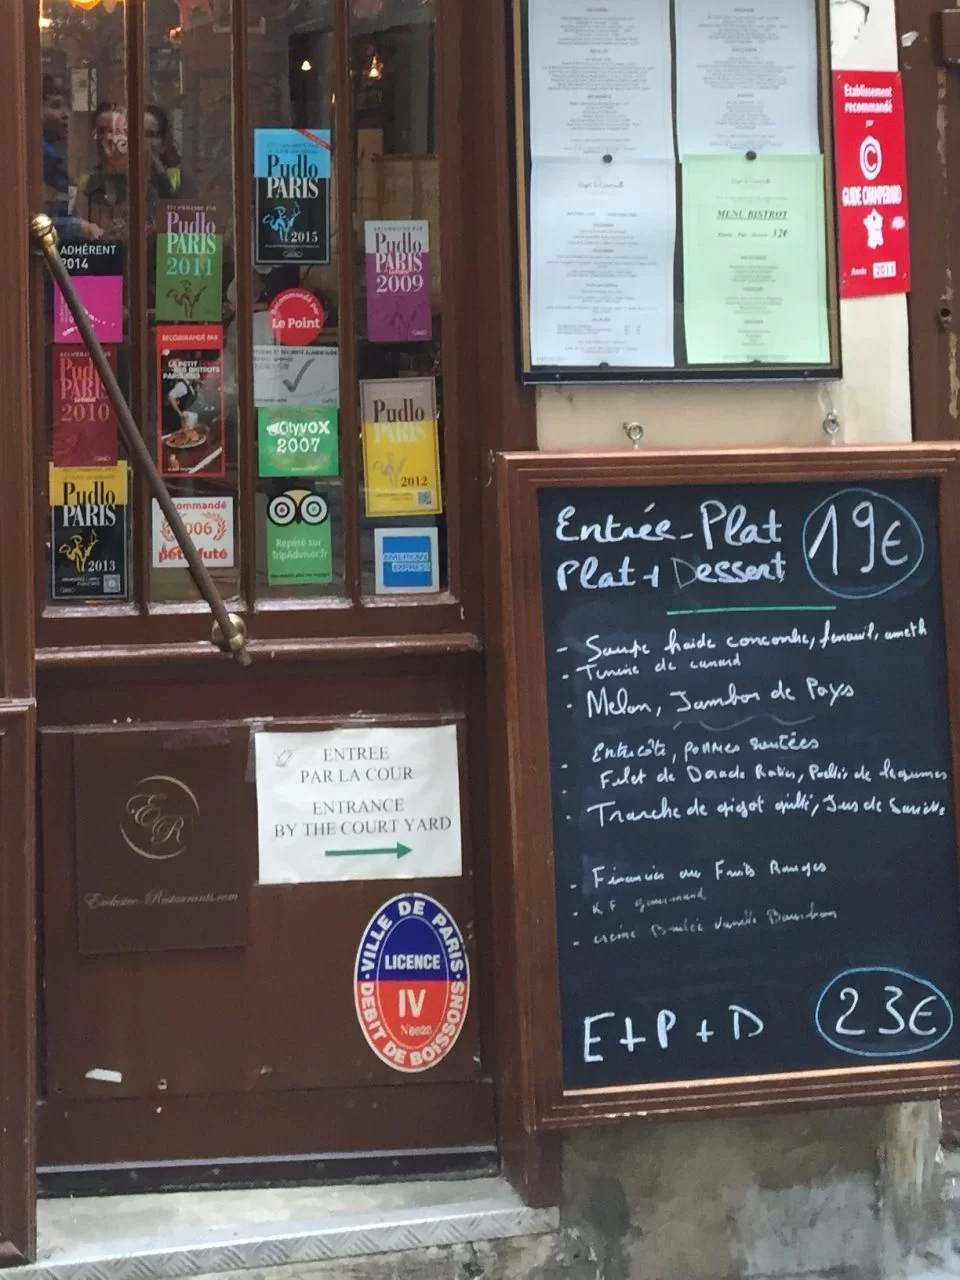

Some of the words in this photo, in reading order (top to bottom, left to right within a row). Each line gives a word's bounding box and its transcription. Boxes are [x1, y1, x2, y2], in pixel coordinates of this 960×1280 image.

[844, 84, 893, 98] Etablissement
[844, 99, 893, 114] recommandé
[267, 153, 318, 178] Pudlo
[266, 176, 319, 199] PARIS
[167, 211, 217, 234] Pudlo
[167, 232, 217, 255] PARIS
[290, 231, 319, 243] 2015
[375, 232, 422, 253] Pudlo
[60, 242, 117, 255] ADHÉRENT
[166, 257, 213, 276] 2011
[375, 252, 423, 273] PARIS
[376, 274, 424, 293] 2009
[272, 318, 286, 329] Le
[287, 317, 321, 329] Point
[60, 357, 100, 380] Pud
[61, 403, 110, 422] 2010
[372, 398, 426, 423] Pudlo
[277, 437, 321, 453] 2007
[400, 475, 428, 487] 2012
[63, 481, 116, 505] Pudlo
[63, 503, 116, 527] PARIS
[175, 501, 227, 510] ommandé
[186, 522, 213, 535] 006
[88, 560, 116, 572] 2013
[654, 658, 677, 673] de
[770, 679, 796, 701] de
[323, 746, 390, 762] ENTREE
[300, 769, 333, 784] PAR
[339, 768, 360, 783] LA
[365, 767, 414, 782] COUR
[656, 767, 676, 783] de
[854, 765, 872, 782] de
[313, 798, 405, 816] ENTRANCE
[686, 798, 708, 817] de
[863, 795, 882, 813] de
[274, 822, 297, 838] BY
[303, 822, 337, 837] THE
[341, 818, 400, 835] COURT
[404, 816, 452, 833] YARD
[360, 913, 393, 972] VILLE
[397, 899, 426, 917] DE
[431, 913, 465, 973] PARIS
[384, 953, 441, 970] LICENCE
[398, 988, 427, 1019] IV
[360, 981, 387, 1042] DEBIT
[382, 1040, 407, 1065] DE
[410, 980, 466, 1067] BOISSONS
